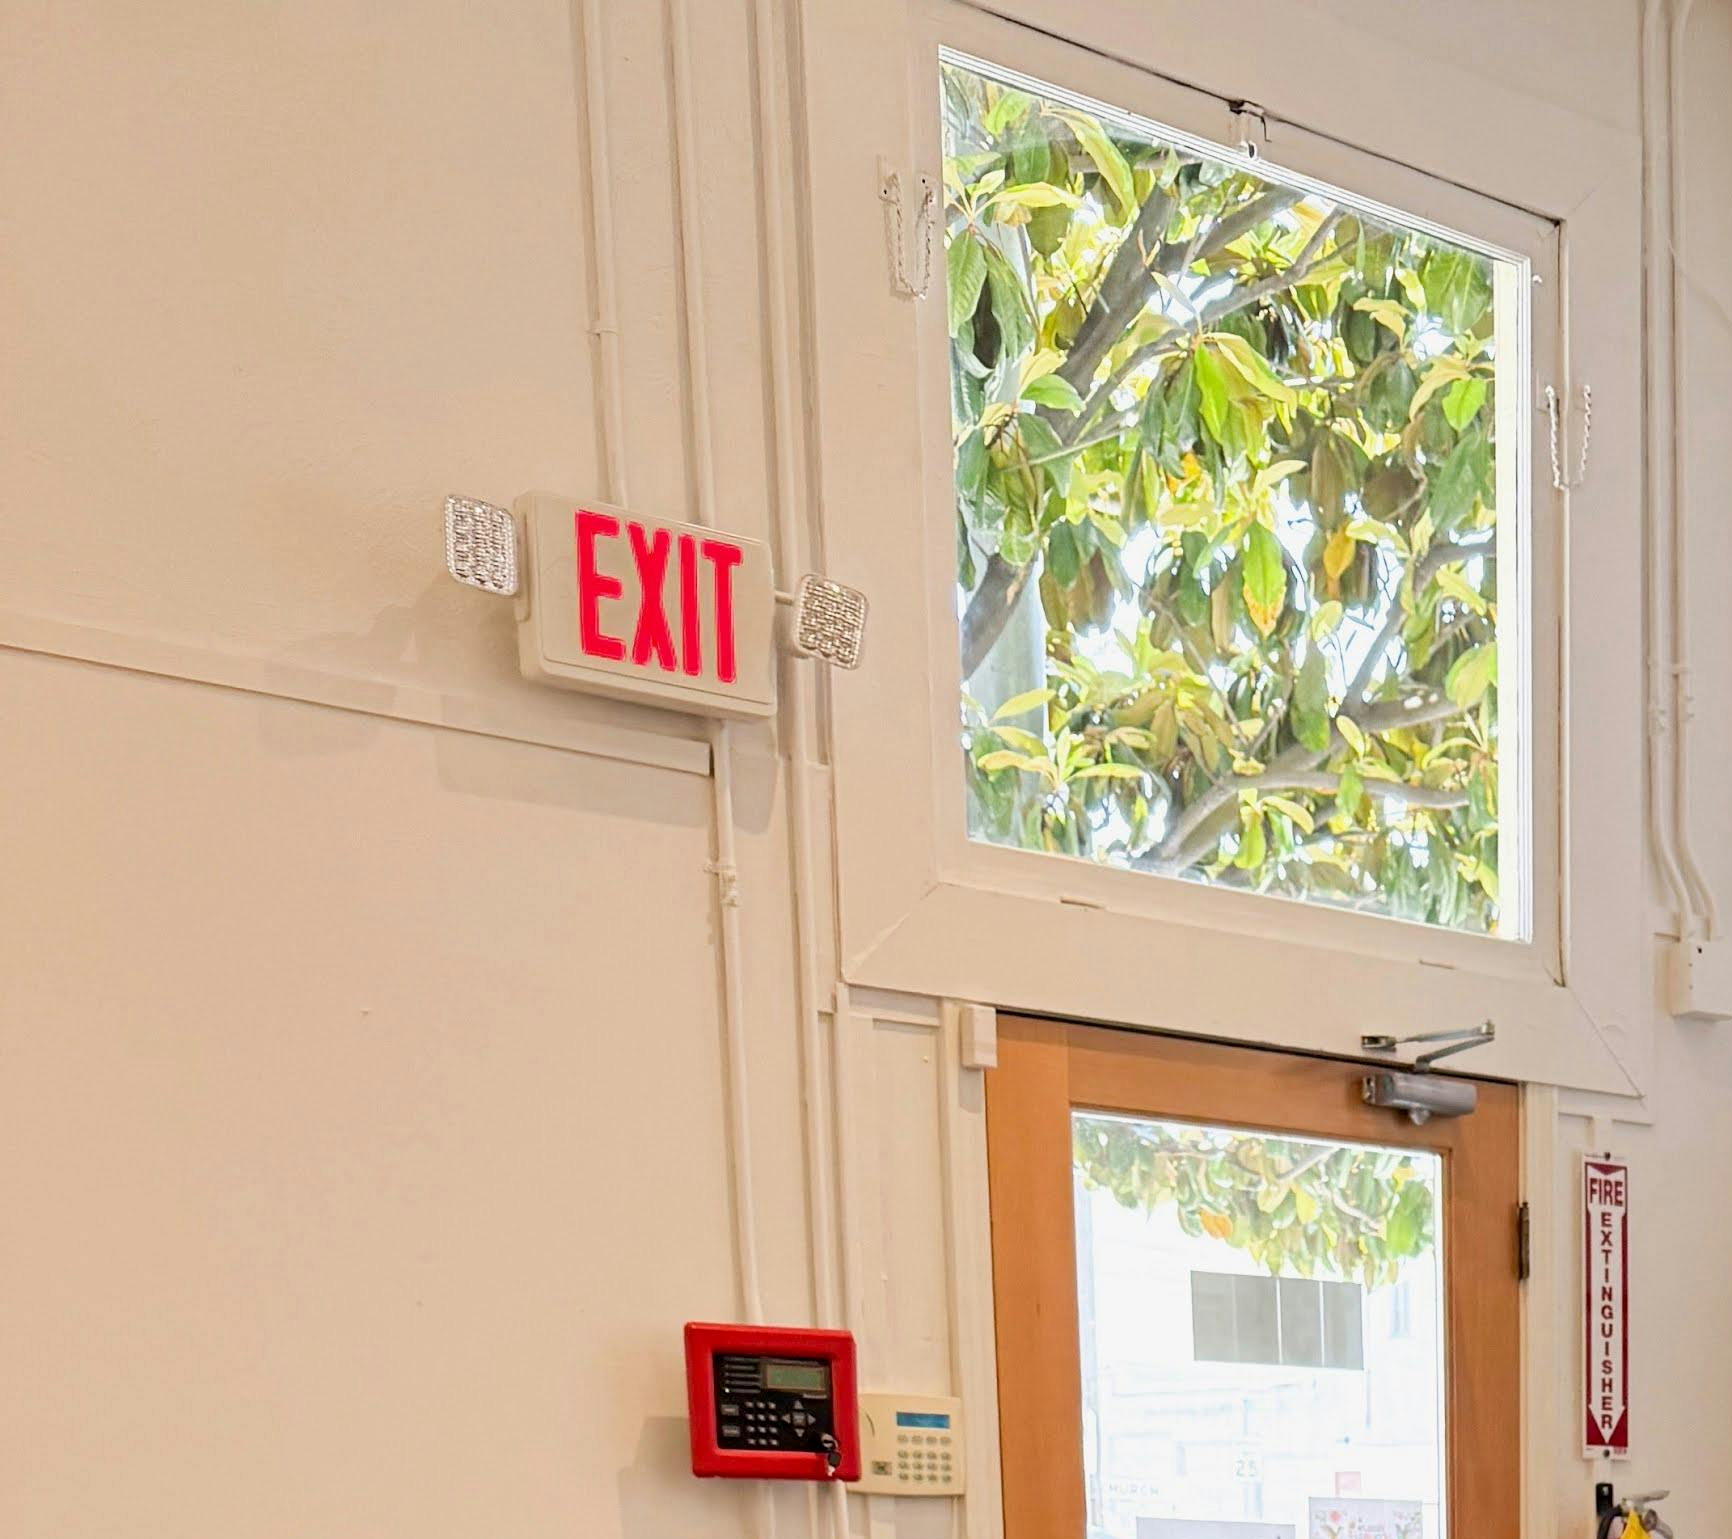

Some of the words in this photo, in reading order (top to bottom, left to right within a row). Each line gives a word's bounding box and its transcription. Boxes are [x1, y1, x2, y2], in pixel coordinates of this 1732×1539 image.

[574, 508, 745, 685] EXIT
[1589, 1177, 1623, 1206] FIRE
[1601, 1212, 1613, 1429] EXTINGUISHER
